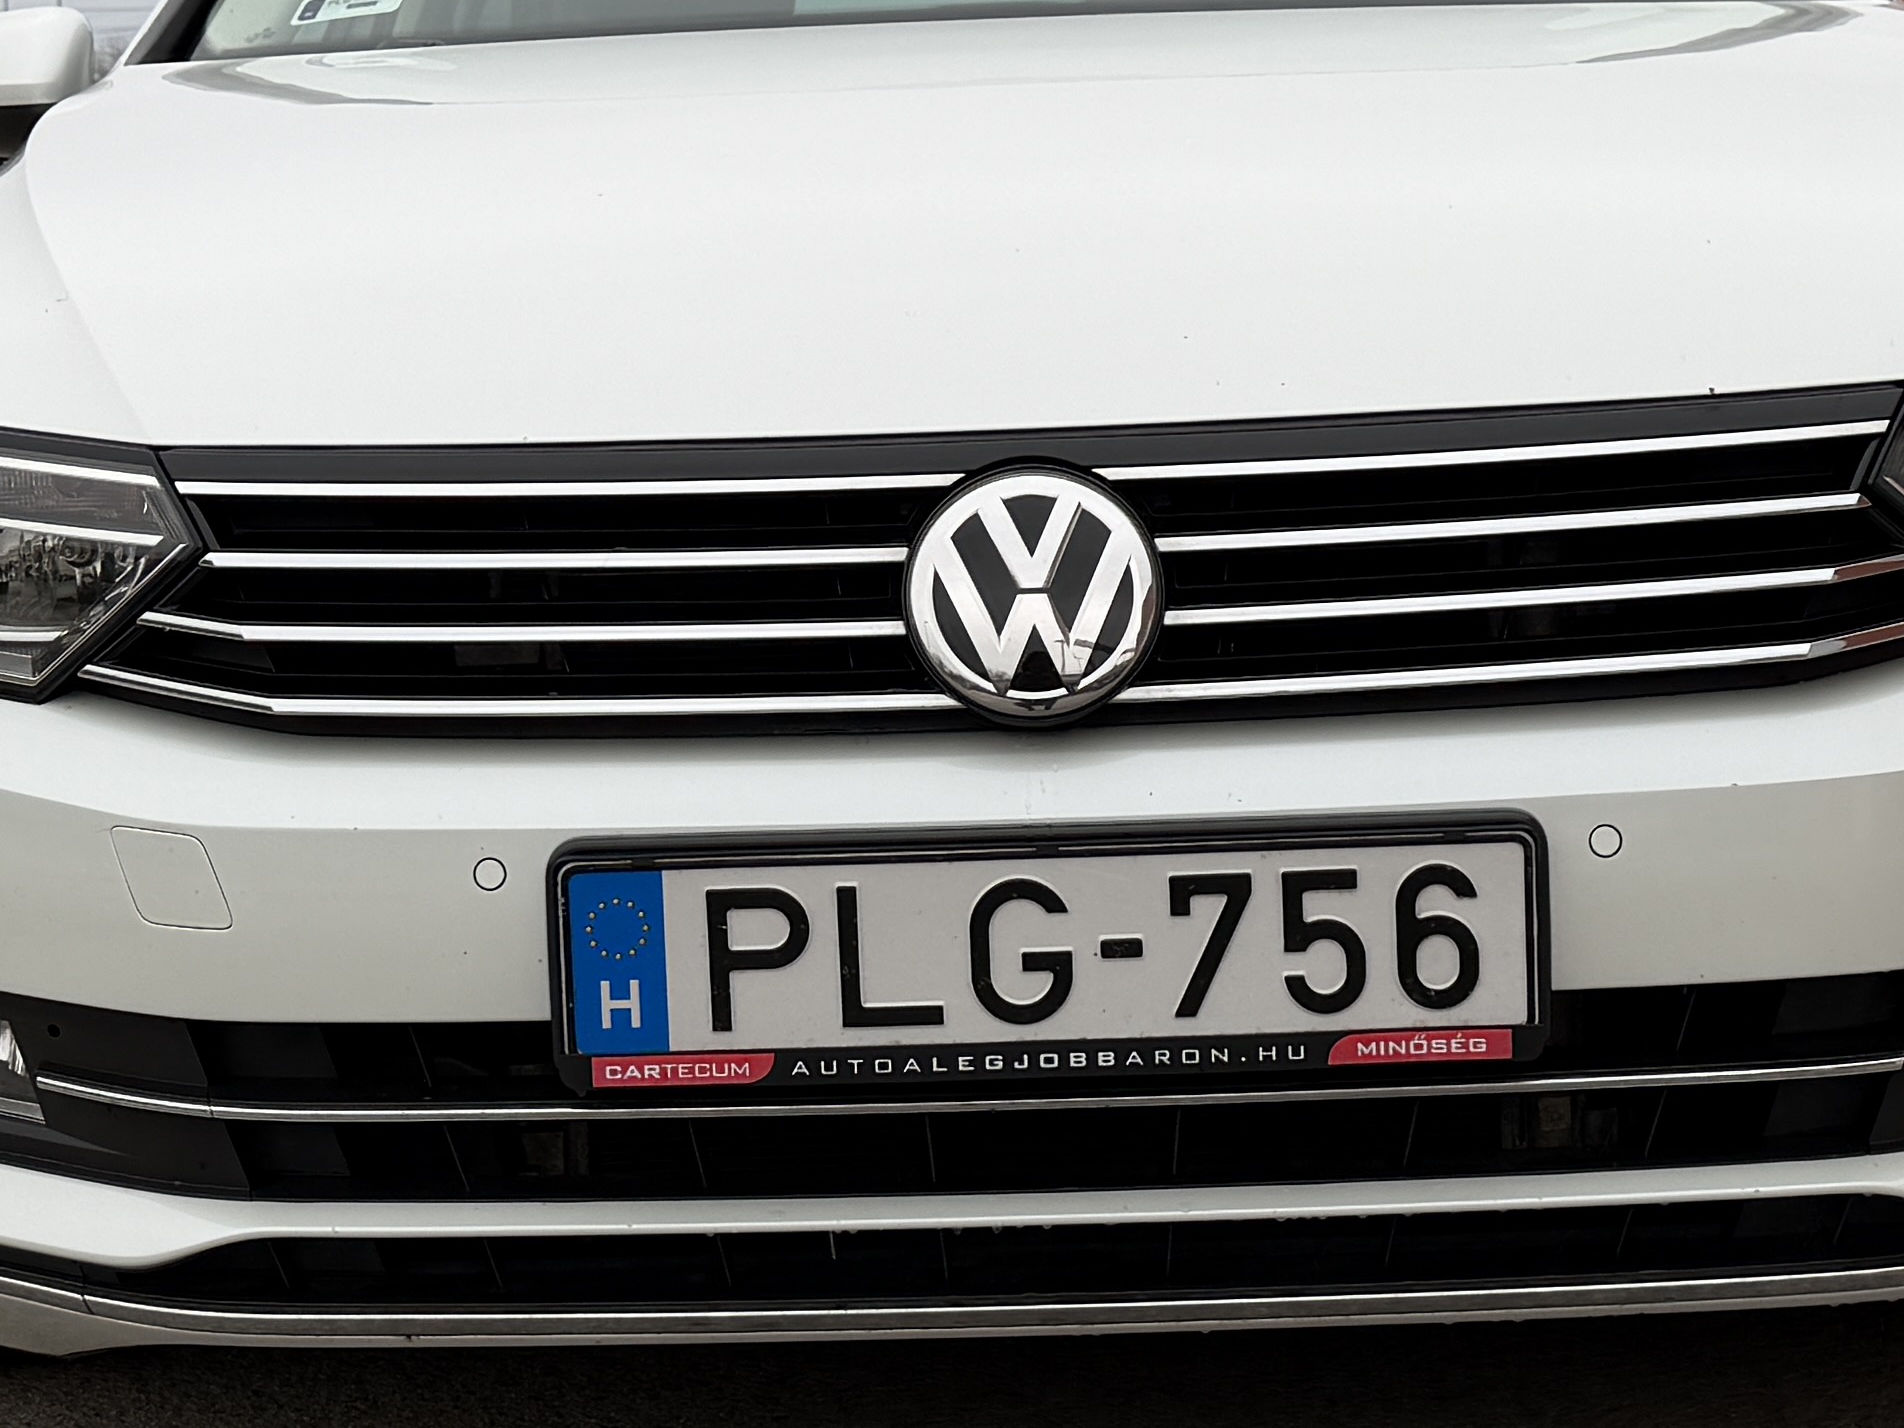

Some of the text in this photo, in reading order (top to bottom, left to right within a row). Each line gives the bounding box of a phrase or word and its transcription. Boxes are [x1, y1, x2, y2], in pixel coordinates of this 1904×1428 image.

[704, 862, 1481, 1033] PLG-756
[600, 979, 642, 1030] H
[605, 1032, 1487, 1081] CARTECUM AUTOALEGJOBBARON.HU MINŐSÉG
